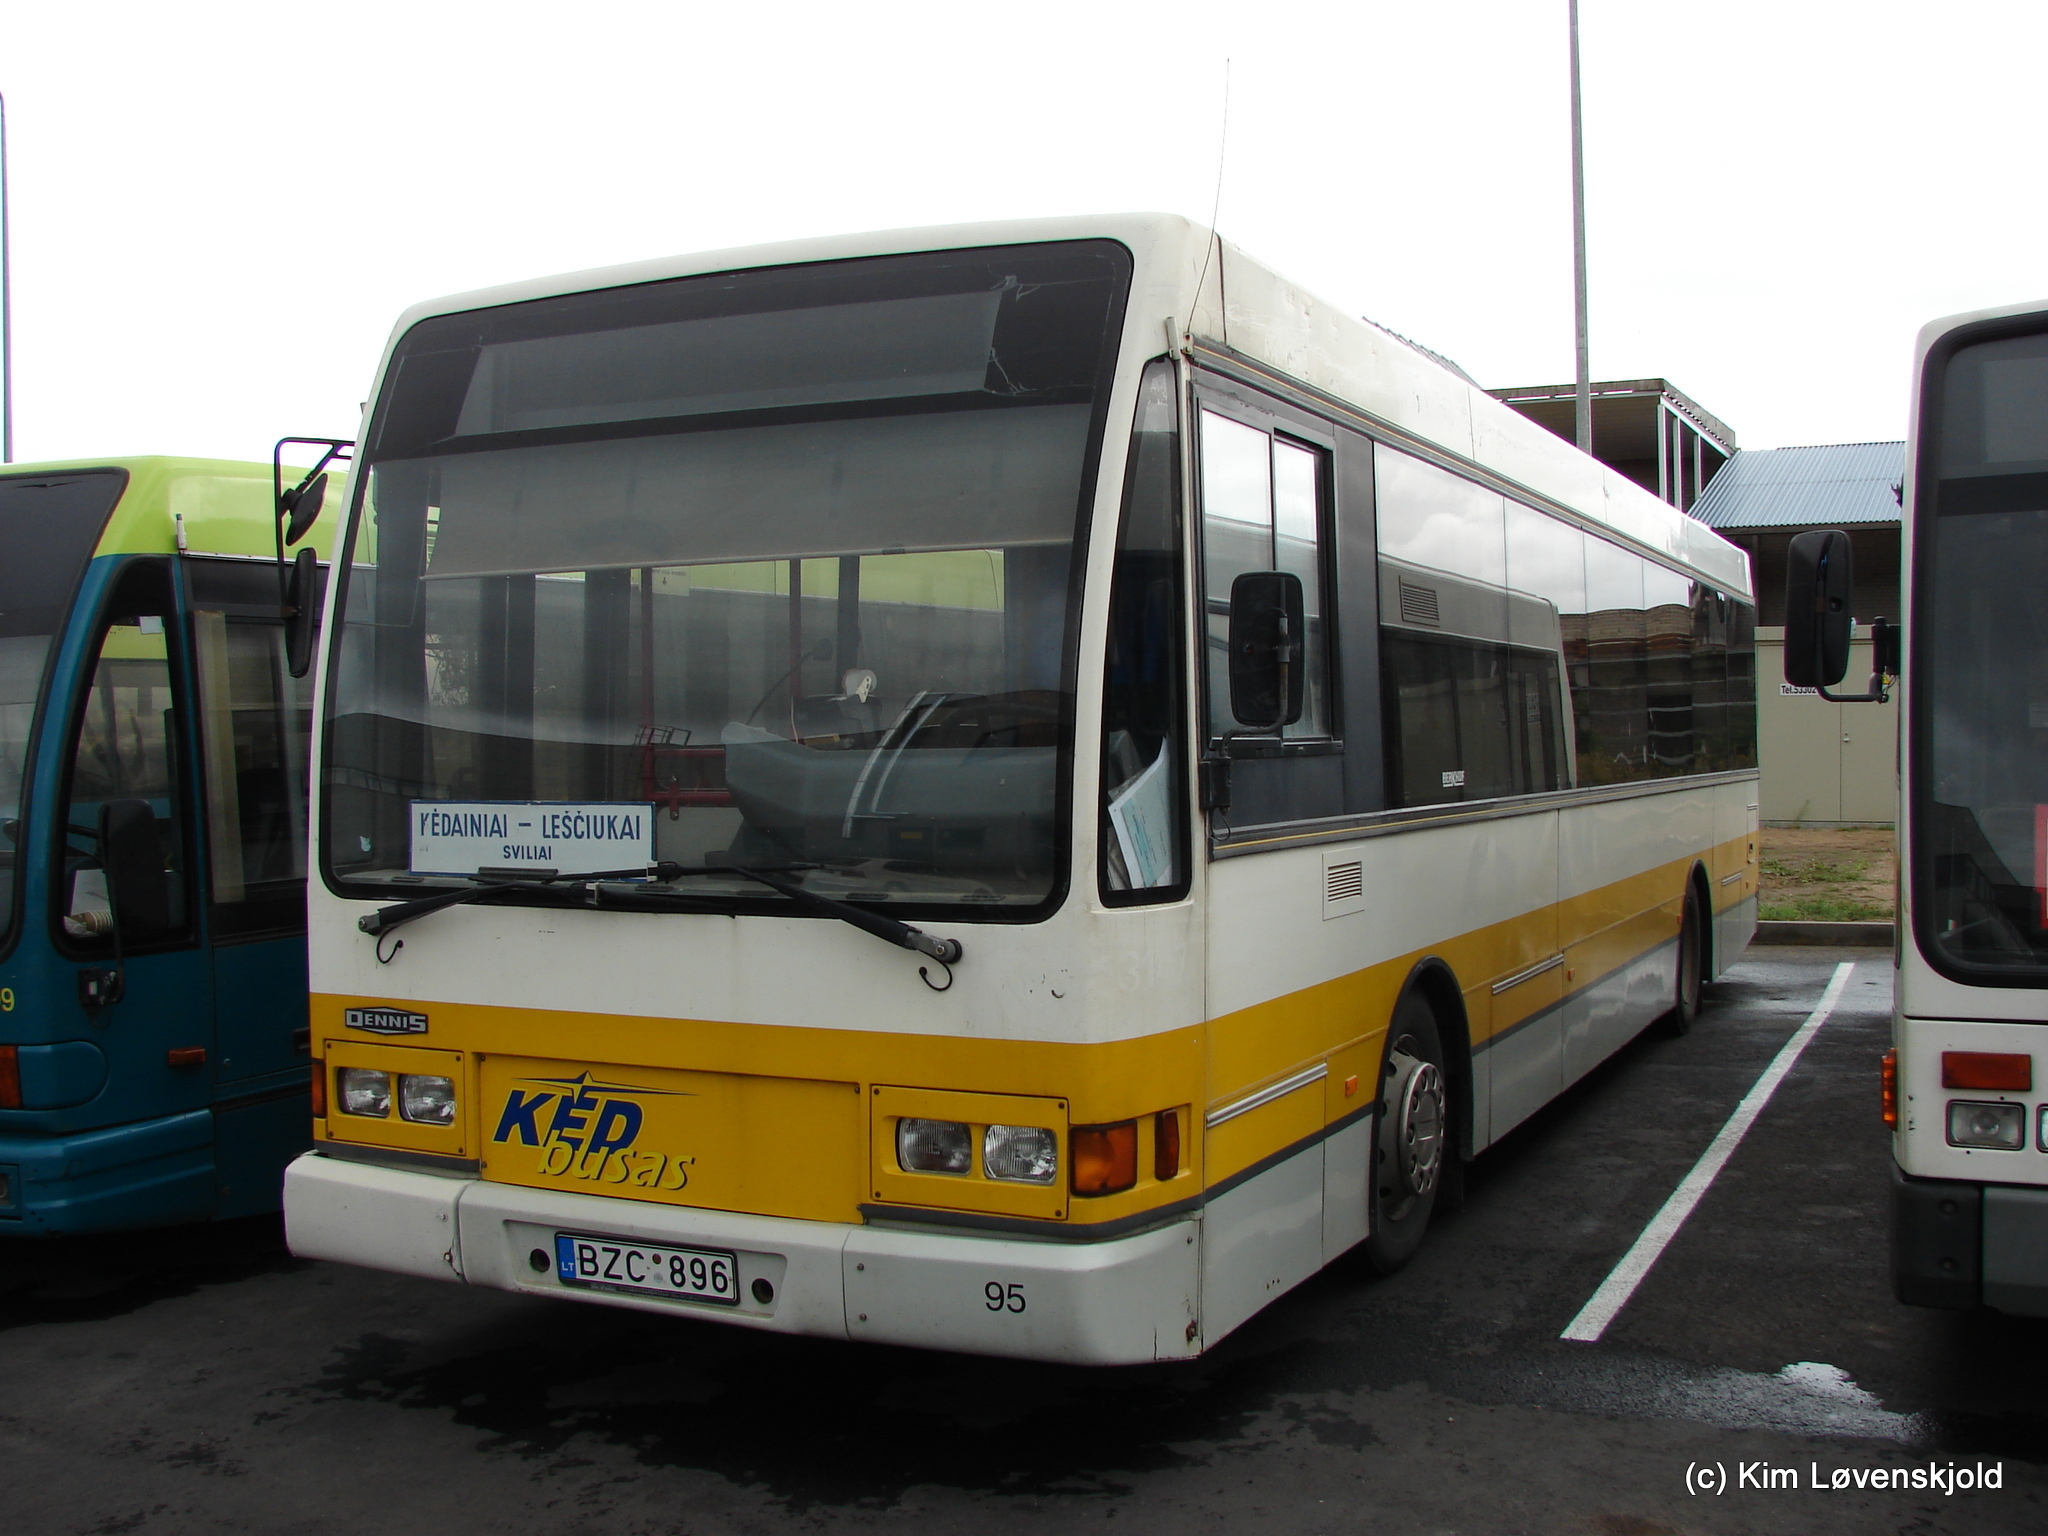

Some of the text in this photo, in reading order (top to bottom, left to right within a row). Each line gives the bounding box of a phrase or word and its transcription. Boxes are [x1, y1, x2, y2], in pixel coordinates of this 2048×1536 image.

[542, 810, 641, 840] LEŠČIUKAI
[503, 845, 552, 860] SVILIAI
[0, 987, 15, 1012] 9
[346, 1010, 426, 1032] DENNIS
[537, 1130, 696, 1191] busas
[561, 1262, 574, 1272] LT
[578, 1244, 646, 1283] BZC
[669, 1255, 728, 1293] 896
[985, 1281, 1026, 1314] 95
